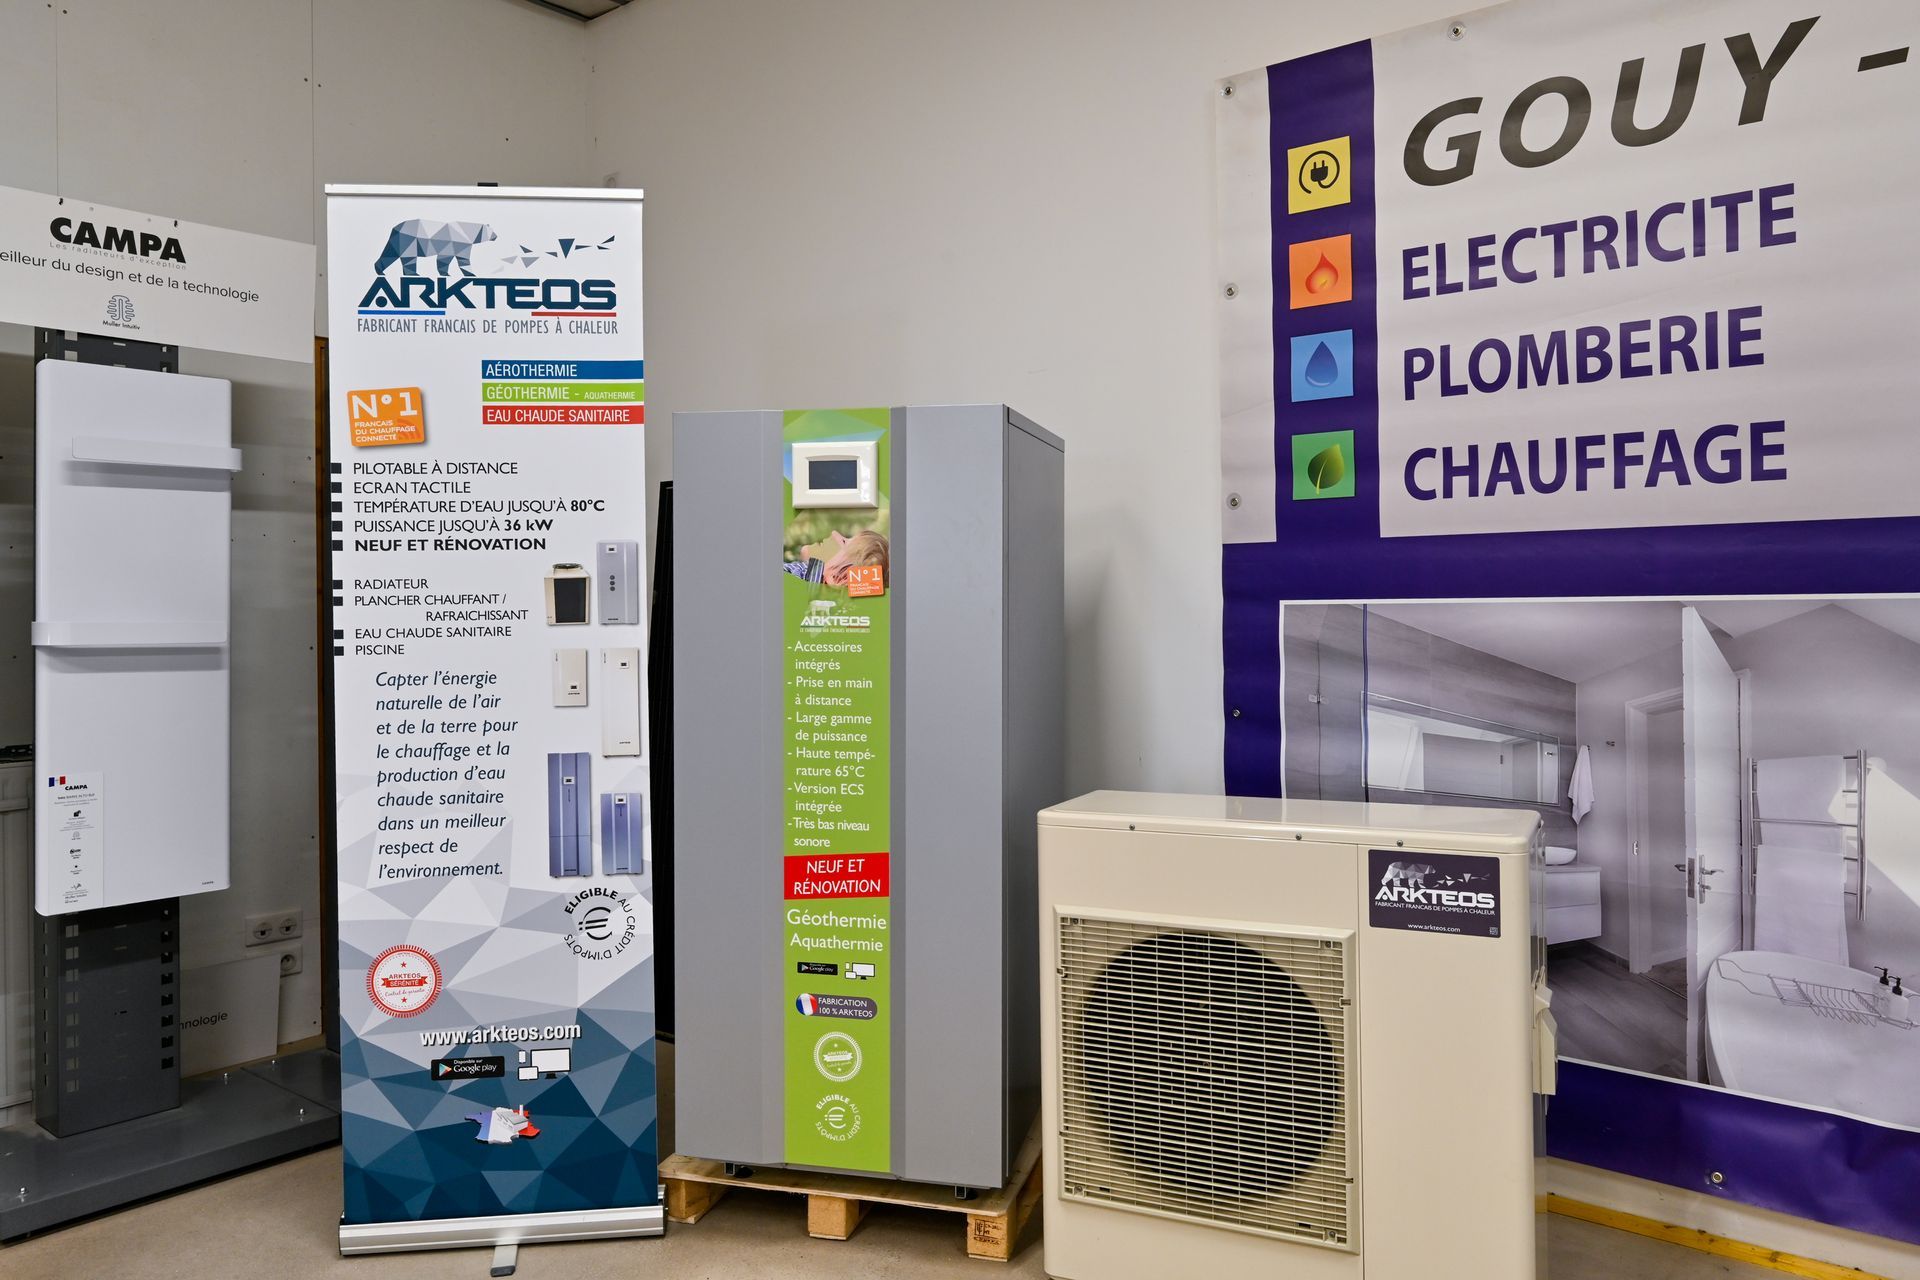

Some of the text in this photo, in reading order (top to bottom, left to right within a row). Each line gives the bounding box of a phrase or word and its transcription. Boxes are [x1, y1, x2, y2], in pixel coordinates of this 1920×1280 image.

[1402, 15, 1910, 187] GOUY -
[50, 217, 186, 263] CAMPA
[1402, 183, 1797, 300] ELECTRICITE
[72, 246, 125, 260] radiateurs
[130, 254, 187, 271] d'exception
[0, 250, 259, 303] eilleur du design et de la technologie
[358, 276, 616, 310] ARKTEOS
[357, 317, 618, 334] FABRICANT FRANCAIS DE POMPES À CHALEUR
[1403, 305, 1764, 401] PLOMBERIE
[485, 360, 578, 377] AÉROTHERMIE
[486, 383, 570, 400] GÉOTHERMIE
[583, 391, 635, 399] AQUATHERMIE
[486, 409, 630, 422] EAU CHAUDE SANITAIRE
[369, 426, 416, 434] CHAUFFAGE
[353, 459, 518, 475] PILOTABLE À DISTANCE
[1403, 420, 1788, 501] CHAUFFAGE
[353, 481, 471, 494] ECRAN TACTILE
[354, 497, 605, 516] TEMPÉRATURE D'EAU JUSQU'À 80°C
[354, 517, 554, 535] PUISSANCE JUSQU'À 36 kW
[355, 536, 546, 551] NEUF ET RÉNOVATION
[354, 579, 429, 590] RADIATEUR
[354, 595, 421, 606] PLANCHER
[424, 594, 500, 605] CHAUFFANT
[425, 610, 528, 622] RAFRAICHISSANT
[801, 616, 870, 626] ARKTEOS
[355, 626, 512, 639] EAU CHAUDE SANITAIRE
[355, 644, 405, 656] PISCINE
[794, 641, 862, 653] Accessoires
[795, 659, 840, 672] intégrés
[375, 671, 498, 690] Capter l'énergie
[796, 677, 872, 689] Prise en main
[375, 694, 501, 711] naturelle de l'air
[795, 695, 852, 706] à distance
[796, 712, 872, 726] Large gamme
[376, 719, 519, 736] et de la terre pour
[795, 730, 867, 743] de puissance
[376, 741, 510, 761] le chauffage et la
[796, 747, 875, 762] Haute tempé-
[377, 766, 506, 787] production d'eau
[796, 766, 865, 778] rature 65°C
[794, 782, 864, 795] Version ECS
[377, 790, 504, 807] chaude sanitaire
[795, 800, 842, 815] intégrée
[378, 814, 506, 831] dans un meilleur
[793, 818, 870, 832] Très bas niveau
[378, 838, 459, 858] respect de
[794, 837, 831, 847] sonore
[378, 862, 504, 878] l'environnement.
[807, 859, 865, 874] NEUF ET
[793, 879, 881, 895] RÉNOVATION
[1375, 886, 1495, 909] ARKTEOS
[1405, 903, 1432, 911] FRANCAIS
[1469, 908, 1495, 916] CHALEUR
[563, 887, 636, 960] ELIGIBLE AU CRÉDIT D'IMPÔTS
[787, 909, 887, 930] Géothermie
[1408, 923, 1461, 933] www.arkteos.com
[790, 932, 883, 952] Aquathermie
[818, 998, 868, 1007] FABRICATION
[838, 1009, 873, 1017] ARKTEOS
[419, 1023, 582, 1047] www.arkteos.com
[453, 1064, 497, 1074] Google play
[816, 1094, 850, 1110] ELIGIBLE
[849, 1103, 859, 1114] AU
